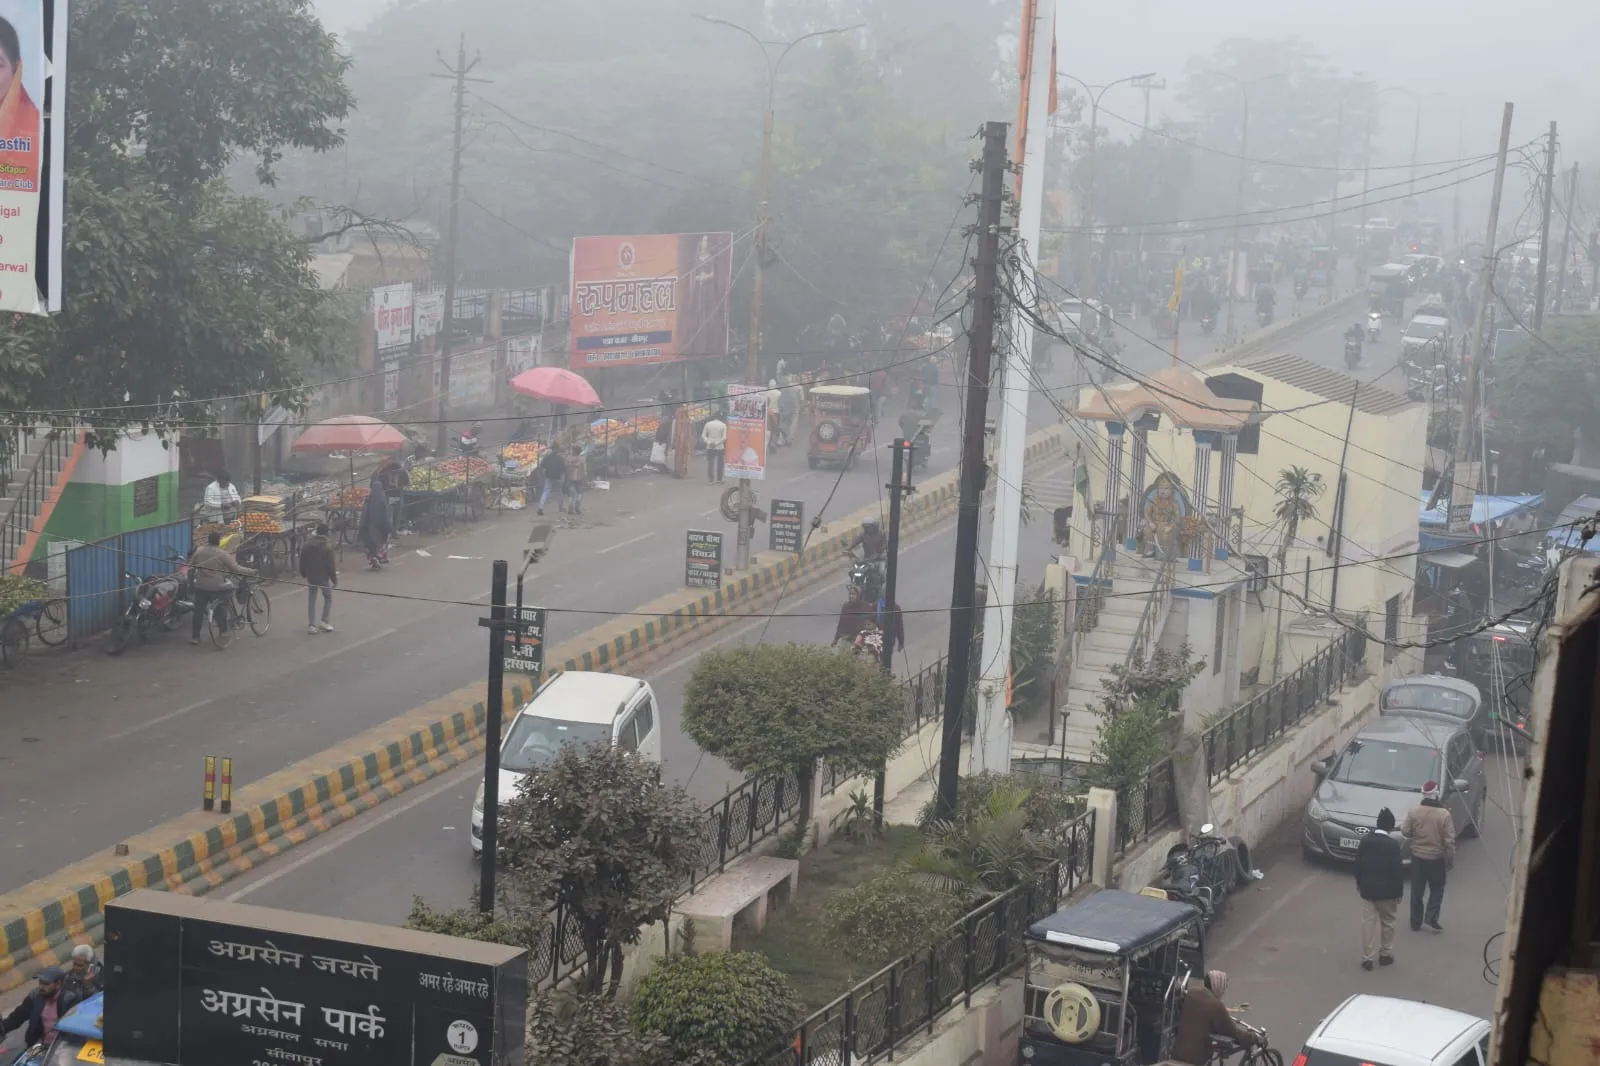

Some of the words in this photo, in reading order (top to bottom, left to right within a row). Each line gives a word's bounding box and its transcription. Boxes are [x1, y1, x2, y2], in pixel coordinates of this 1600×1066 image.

[14, 179, 32, 189] Club
[207, 940, 304, 969] अग्रसेन
[311, 955, 382, 981] जयते
[419, 972, 440, 992] अमर
[442, 972, 454, 993] रहे
[455, 978, 476, 997] अमर
[477, 977, 489, 999] रहे
[200, 986, 305, 1027] अग्रसेन
[320, 1004, 386, 1039] पार्क
[313, 1037, 349, 1051] सभा
[459, 1031, 465, 1045] 1
[264, 1047, 323, 1066] सीतापुर
